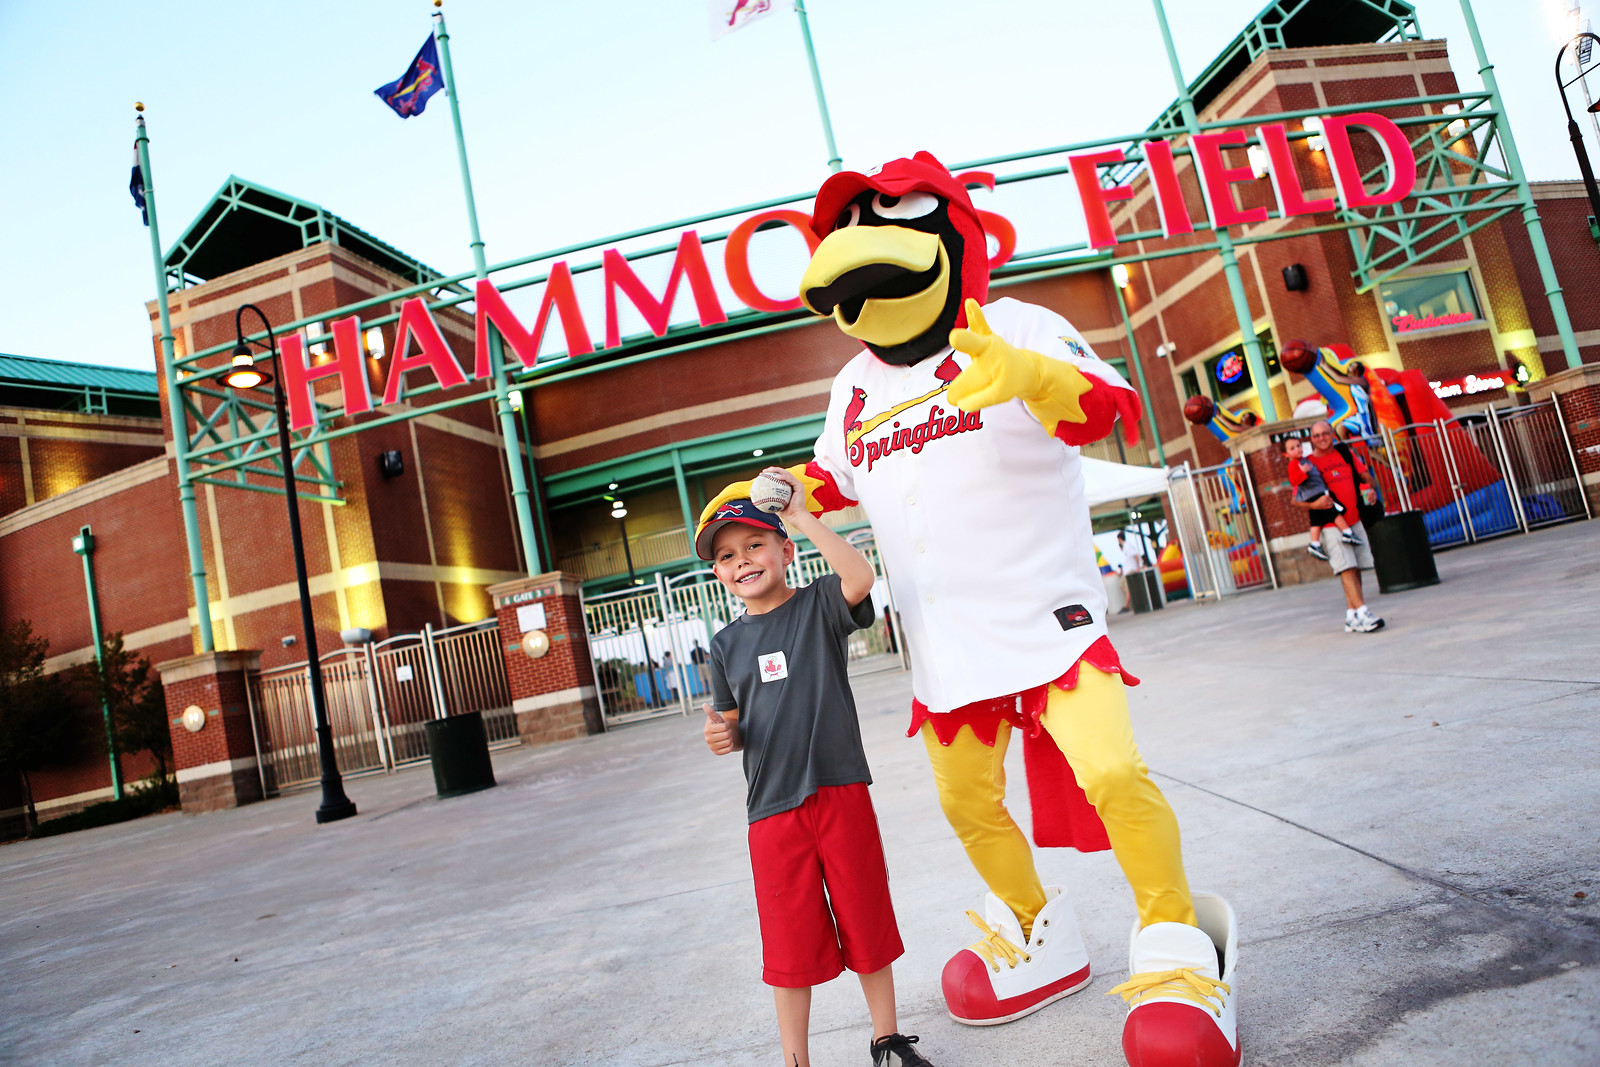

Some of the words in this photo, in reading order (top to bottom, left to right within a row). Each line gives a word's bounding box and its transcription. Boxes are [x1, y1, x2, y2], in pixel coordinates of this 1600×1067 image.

[279, 171, 1017, 431] HAMMOS
[1067, 112, 1417, 250] FIELD
[1465, 374, 1505, 394] Store
[850, 404, 983, 473] Springfield
[513, 591, 533, 603] GATE
